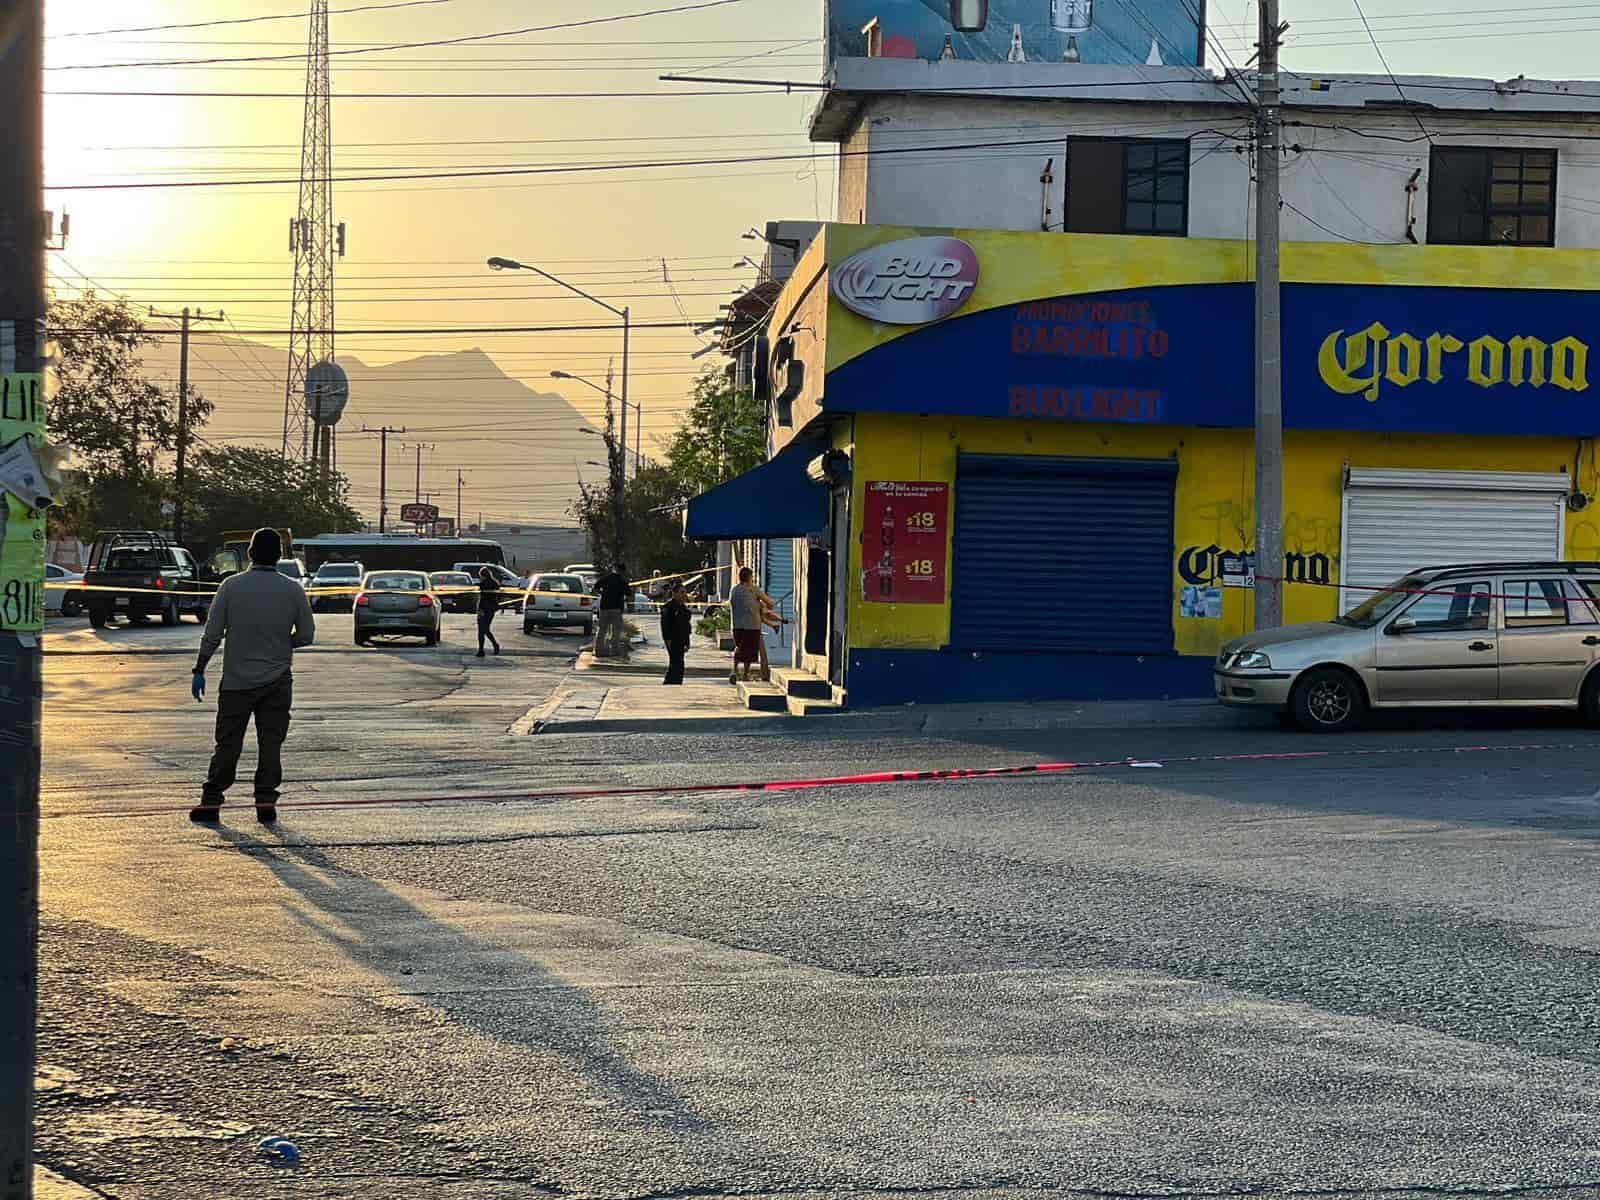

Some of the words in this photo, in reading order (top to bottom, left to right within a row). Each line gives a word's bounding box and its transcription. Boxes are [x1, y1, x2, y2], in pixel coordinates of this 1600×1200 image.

[875, 256, 963, 279] BUD
[854, 278, 975, 302] LIGHT
[1011, 327, 1169, 359] BARRILITO
[1318, 320, 1590, 402] Corona
[1008, 385, 1070, 418] BUD
[1073, 386, 1162, 420] LIGHT
[906, 511, 935, 527] $18
[905, 559, 933, 575] $18
[1178, 544, 1330, 586] Cona
